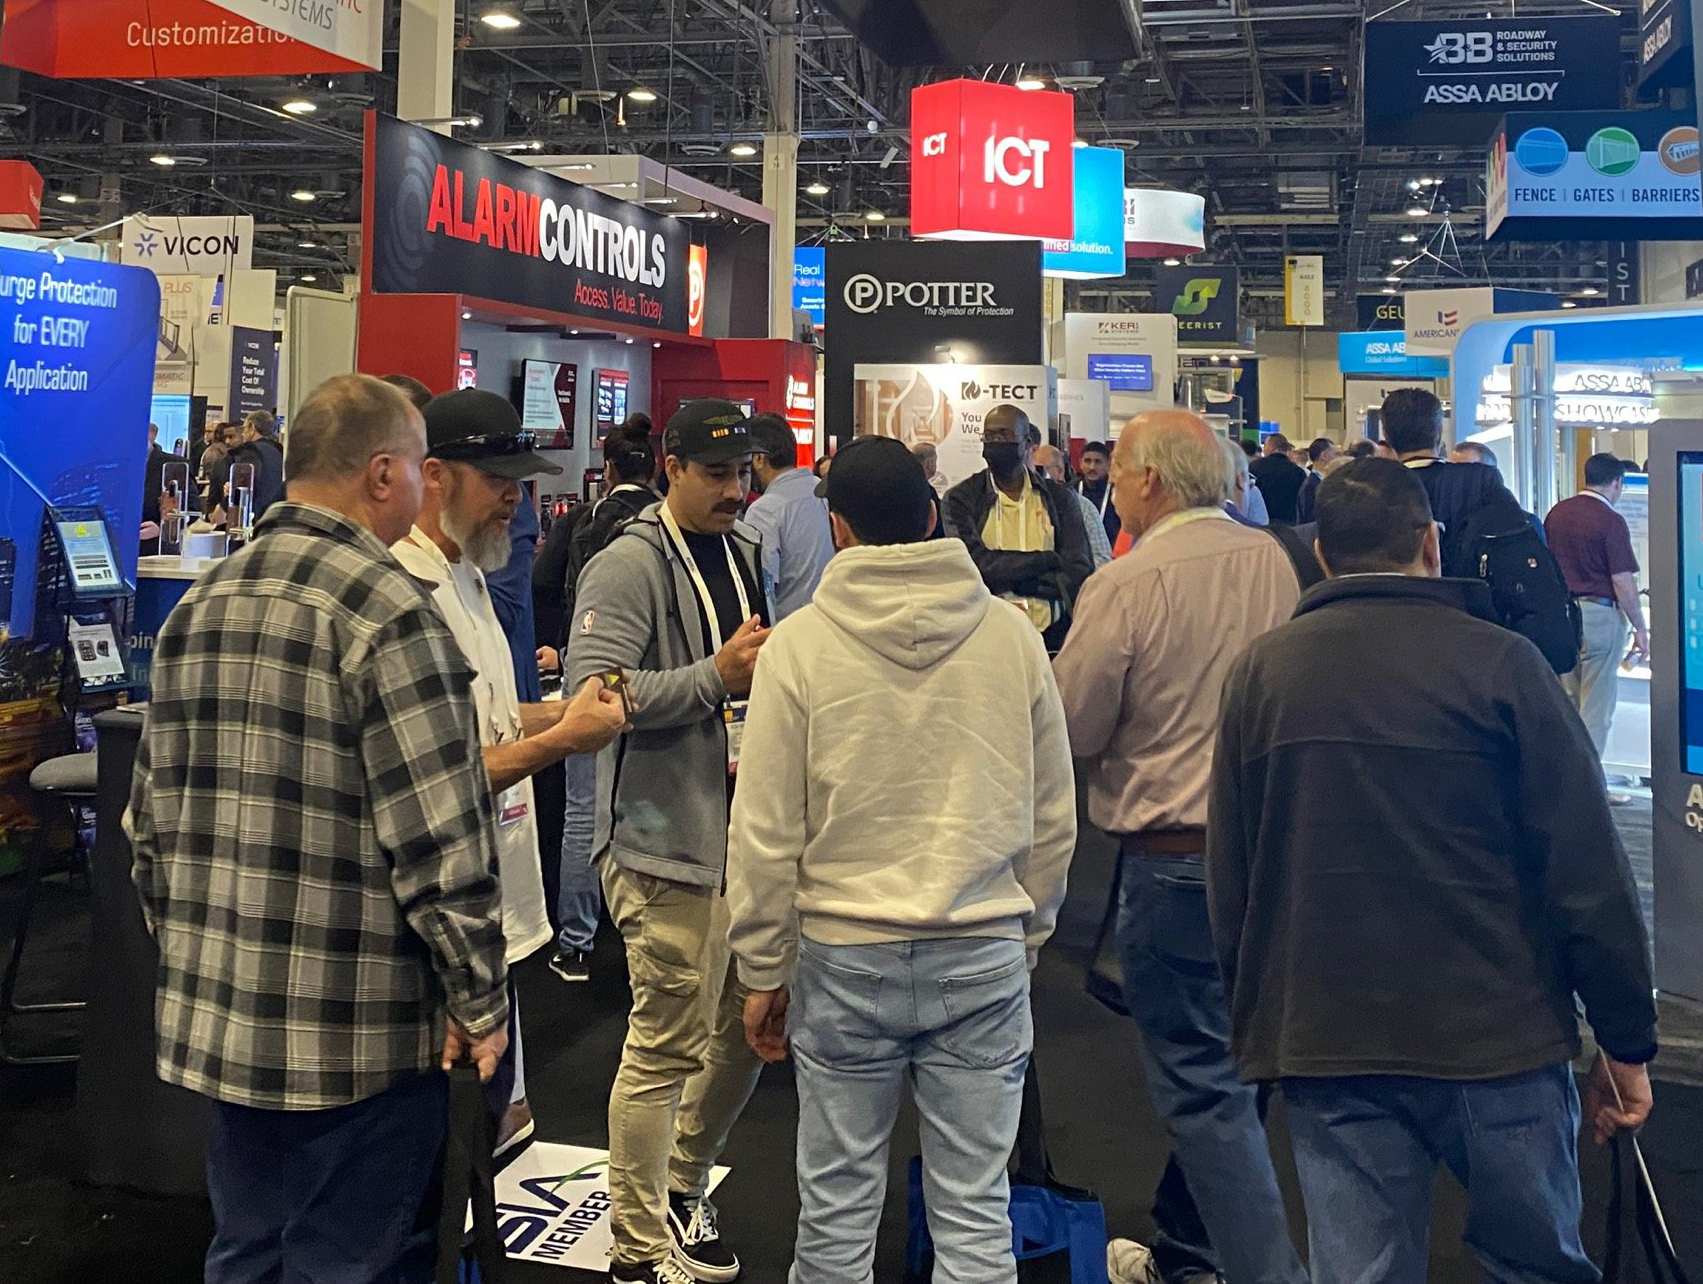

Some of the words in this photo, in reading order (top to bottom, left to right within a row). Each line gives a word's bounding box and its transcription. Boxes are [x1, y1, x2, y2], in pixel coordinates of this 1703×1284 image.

[127, 20, 295, 46] Customizatio
[1496, 30, 1547, 40] ROADWAY
[1496, 42, 1504, 51] &
[1506, 41, 1557, 50] SECURITY
[1496, 52, 1556, 62] SOLUTIONS
[1424, 84, 1483, 104] ASSA
[1485, 82, 1559, 103] ABLOY
[922, 132, 947, 157] ICT
[984, 134, 1050, 189] ICT
[1515, 188, 1557, 202] FENCE
[1573, 187, 1615, 202] GATES
[1632, 187, 1700, 202] BARRIERS
[163, 235, 239, 256] VICON
[794, 263, 820, 276] Real
[0, 274, 36, 305] urge
[40, 271, 118, 309] Protection
[574, 277, 611, 310] Access.
[885, 282, 998, 307] POTTER
[924, 306, 937, 316] The
[938, 306, 966, 318] Symbol
[966, 306, 975, 316] of
[976, 306, 1014, 316] Protection
[13, 314, 38, 345] for
[40, 315, 90, 349] EVERY
[1178, 321, 1222, 330] EERIST
[1365, 342, 1391, 354] ASSA
[4, 359, 88, 396] Application
[961, 411, 982, 423] You
[961, 423, 981, 434] We
[530, 1190, 612, 1261] MEMBER
